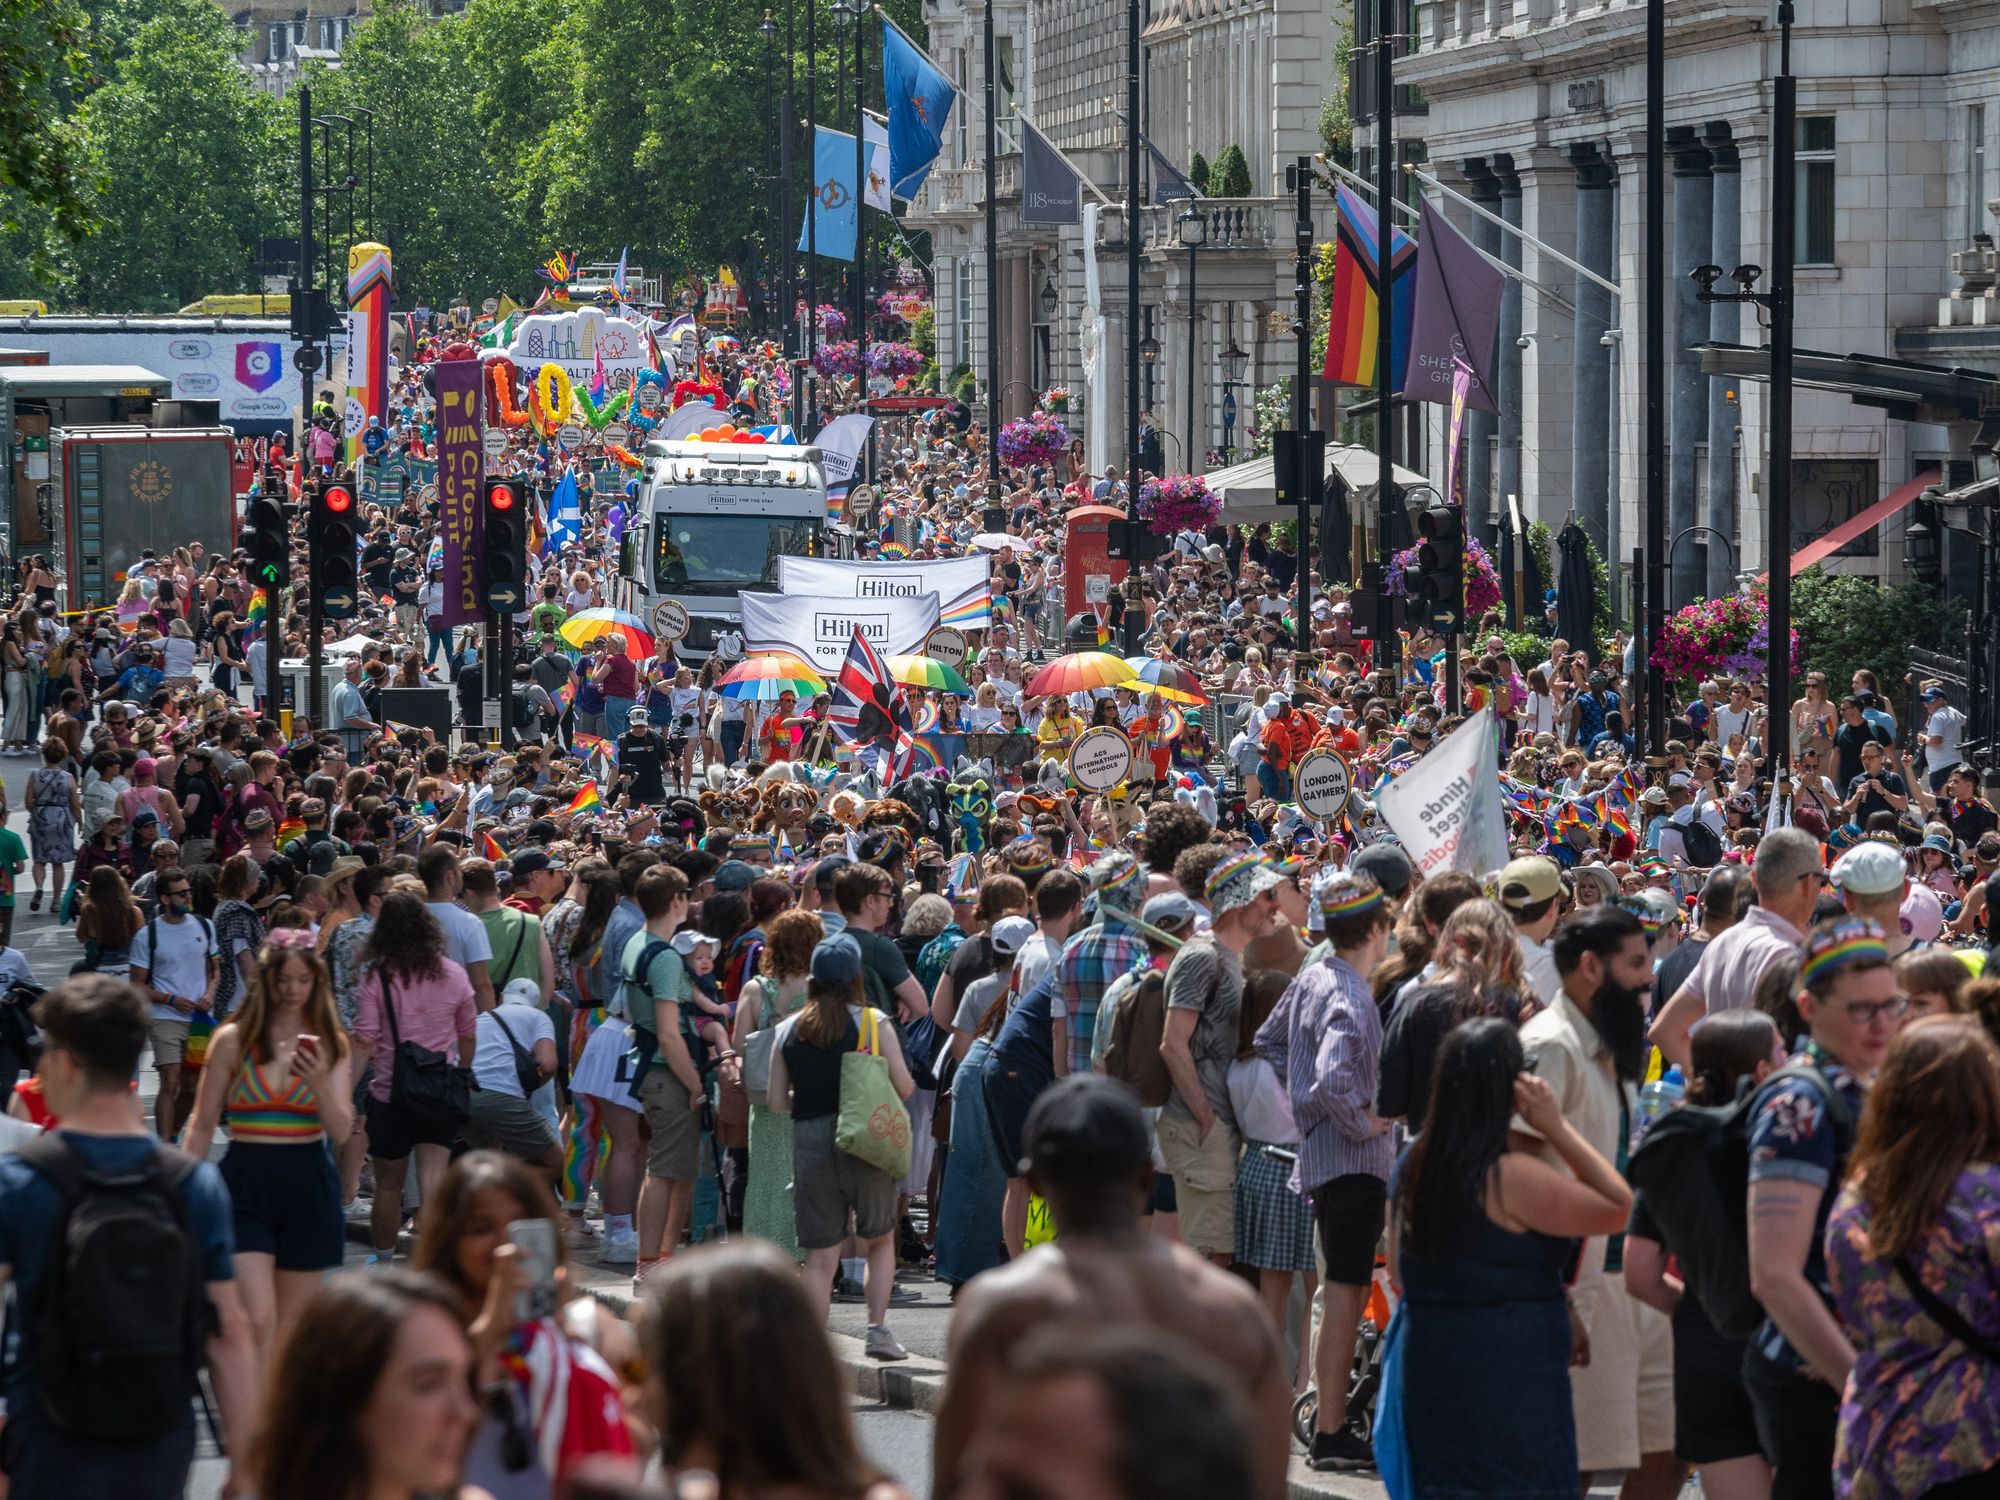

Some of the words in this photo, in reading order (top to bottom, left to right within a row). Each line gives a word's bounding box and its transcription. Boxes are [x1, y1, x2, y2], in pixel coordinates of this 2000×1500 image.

[1029, 192, 1048, 208] 118
[892, 302, 912, 313] Hard
[1430, 371, 1480, 389] GRD
[160, 465, 172, 479] TV
[130, 483, 173, 502] SERVICES
[710, 496, 735, 504] Hilton
[862, 580, 917, 597] Hilton
[656, 617, 683, 632] HELPLINE
[659, 609, 685, 626] TEENAGE
[822, 619, 883, 637] Hilon
[816, 646, 837, 655] FOR
[928, 643, 963, 657] HILTON
[1076, 751, 1128, 771] INTERNATIONAL
[1093, 749, 1108, 759] ACS
[1087, 761, 1119, 775] SCHOOLS
[1303, 772, 1342, 788] LONDON
[1303, 785, 1346, 801] GAYMERS
